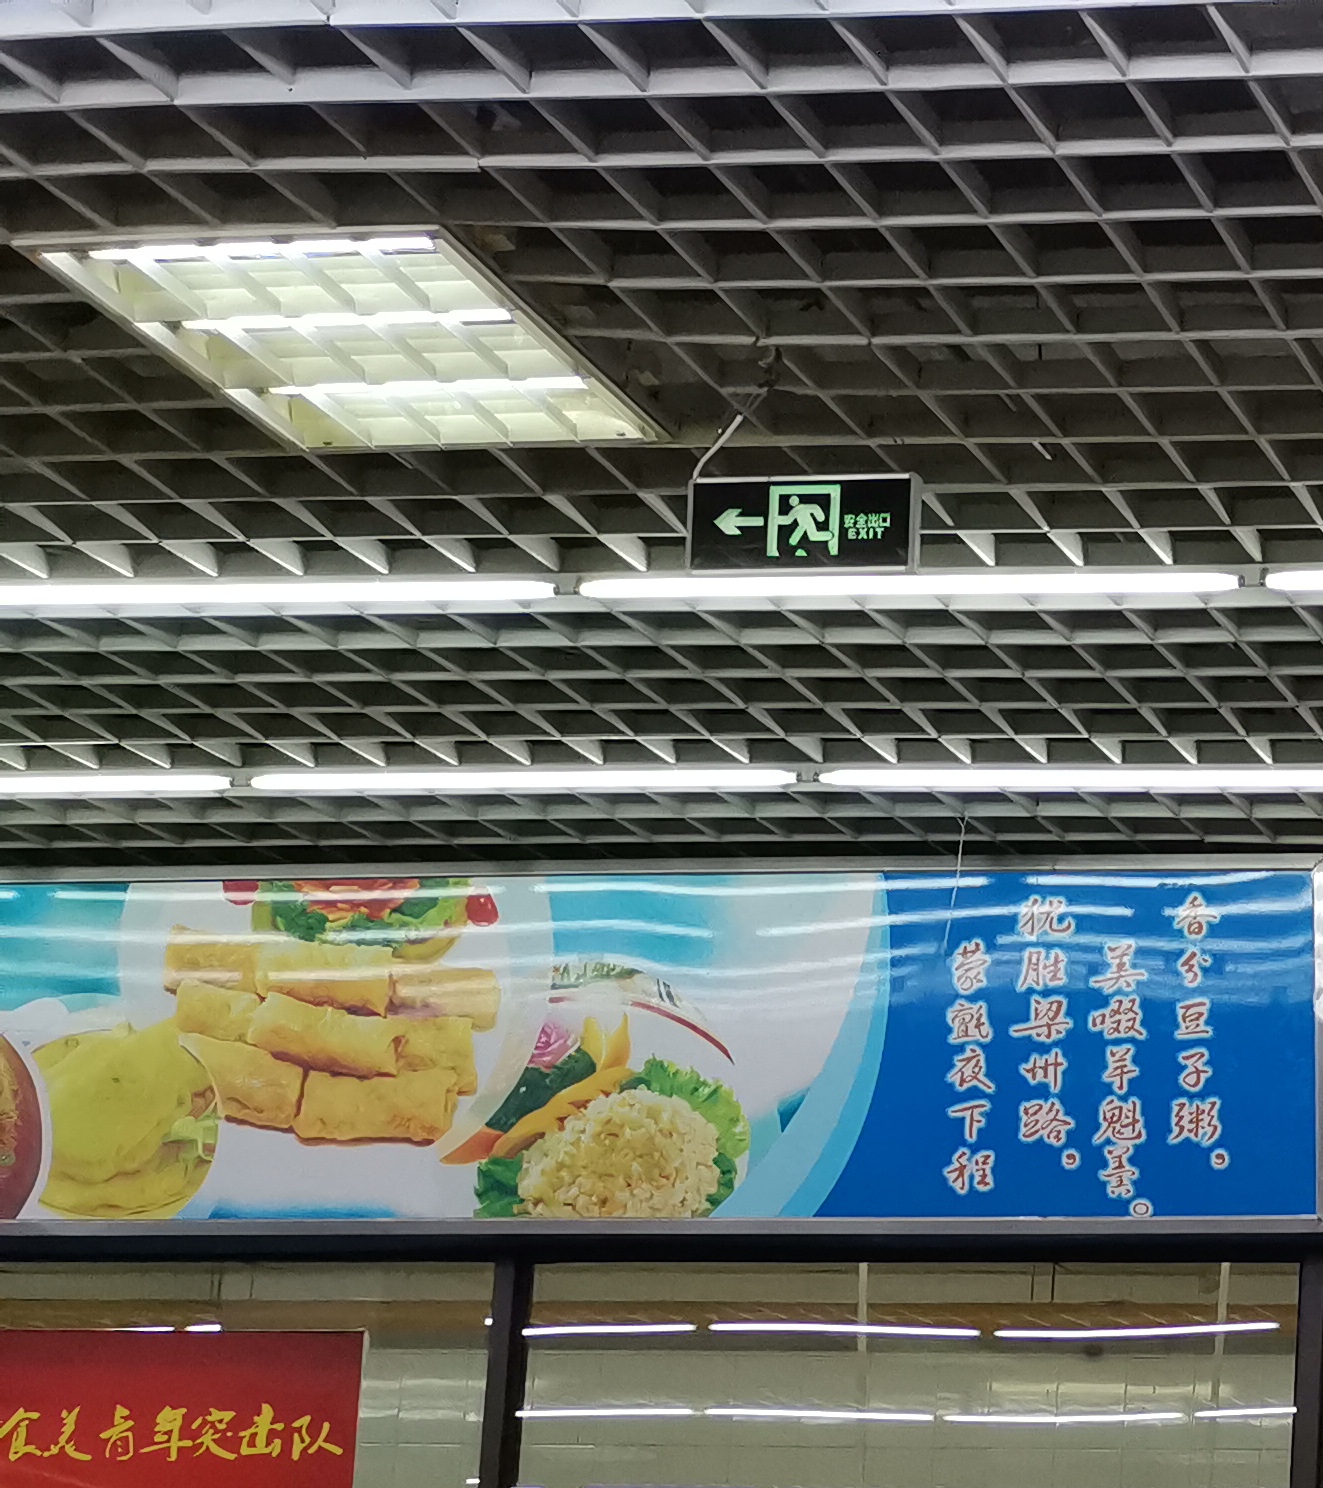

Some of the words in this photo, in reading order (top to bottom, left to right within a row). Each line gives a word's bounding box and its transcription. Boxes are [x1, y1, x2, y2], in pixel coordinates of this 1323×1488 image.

[843, 512, 891, 528] 安全出口
[848, 527, 885, 540] EXIT
